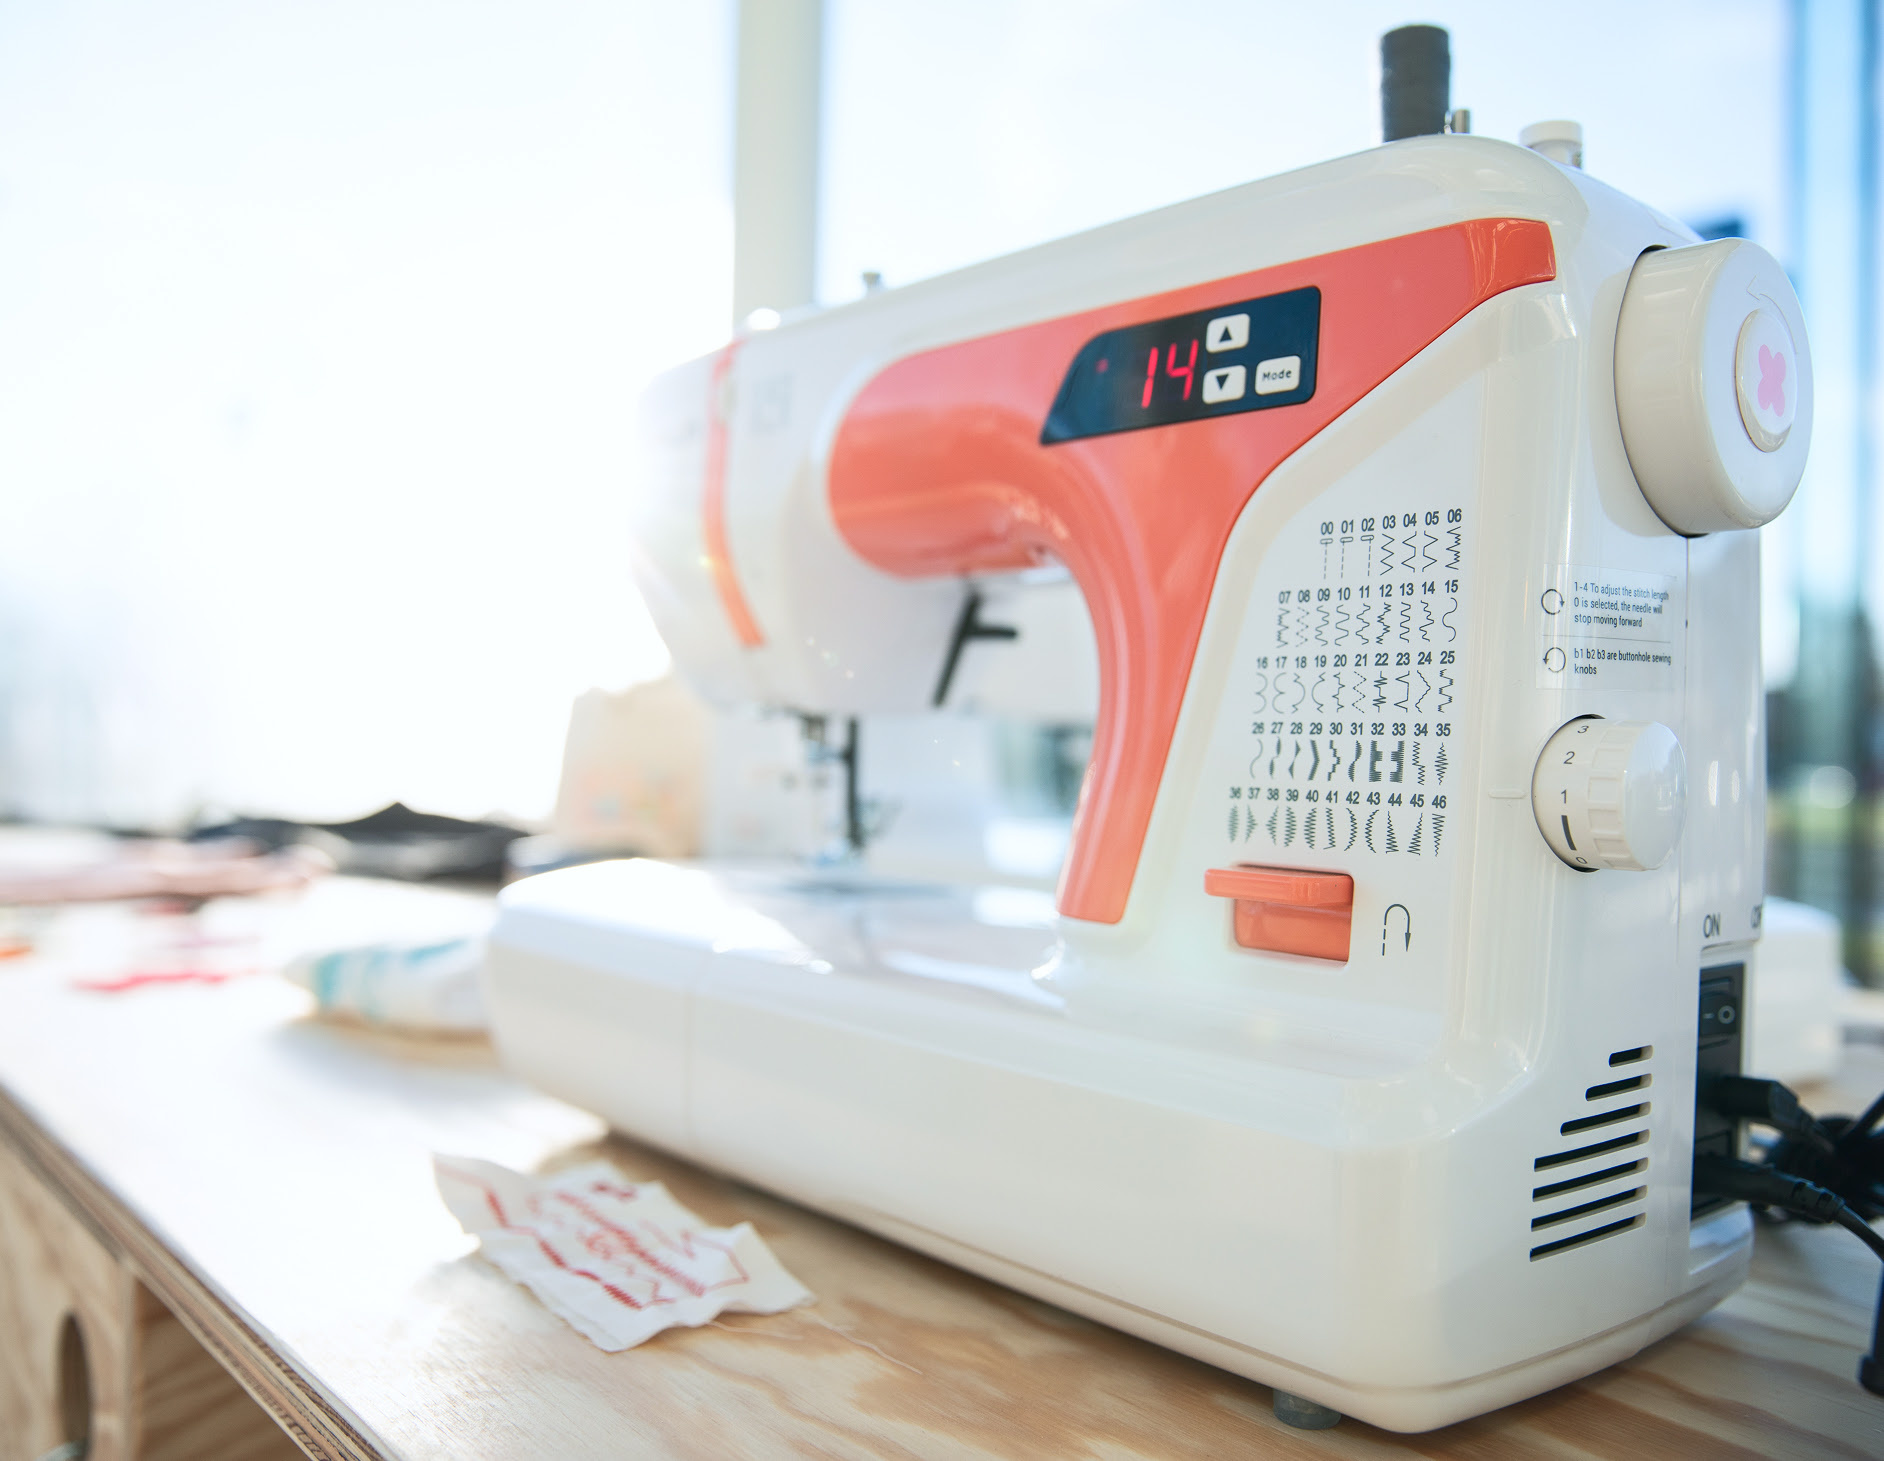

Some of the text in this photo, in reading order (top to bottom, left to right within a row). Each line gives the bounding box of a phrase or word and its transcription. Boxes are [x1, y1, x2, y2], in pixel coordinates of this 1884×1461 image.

[1141, 339, 1199, 409] 14
[1262, 368, 1292, 380] Mode
[1321, 508, 1462, 535] 00 01 02 03 04 05 06
[1279, 579, 1458, 604] 07 08 09 10 11 12 13 14 15
[1574, 582, 1669, 602] 1-4 To adjust the stitch length
[1582, 598, 1589, 608] is
[1590, 600, 1619, 611] selected,
[1621, 602, 1631, 612] the
[1632, 603, 1652, 614] needle
[1653, 606, 1663, 614] will
[1574, 615, 1643, 627] stop moving forward
[1256, 651, 1455, 669] 16 17 18 19 20 21 22 23 24 25
[1574, 648, 1672, 665] b1 b2 b3 are buttonhole sewing
[1574, 664, 1597, 674] knobs
[1252, 722, 1451, 737] 26 27 28 29 30 31 32 33 34 35
[1563, 751, 1576, 765] 2
[1229, 787, 1446, 809] 36 37 38 39 40 41 42 43 44 45 46
[1560, 789, 1567, 804] 1
[1576, 856, 1588, 864] 0
[1703, 913, 1721, 938] ON
